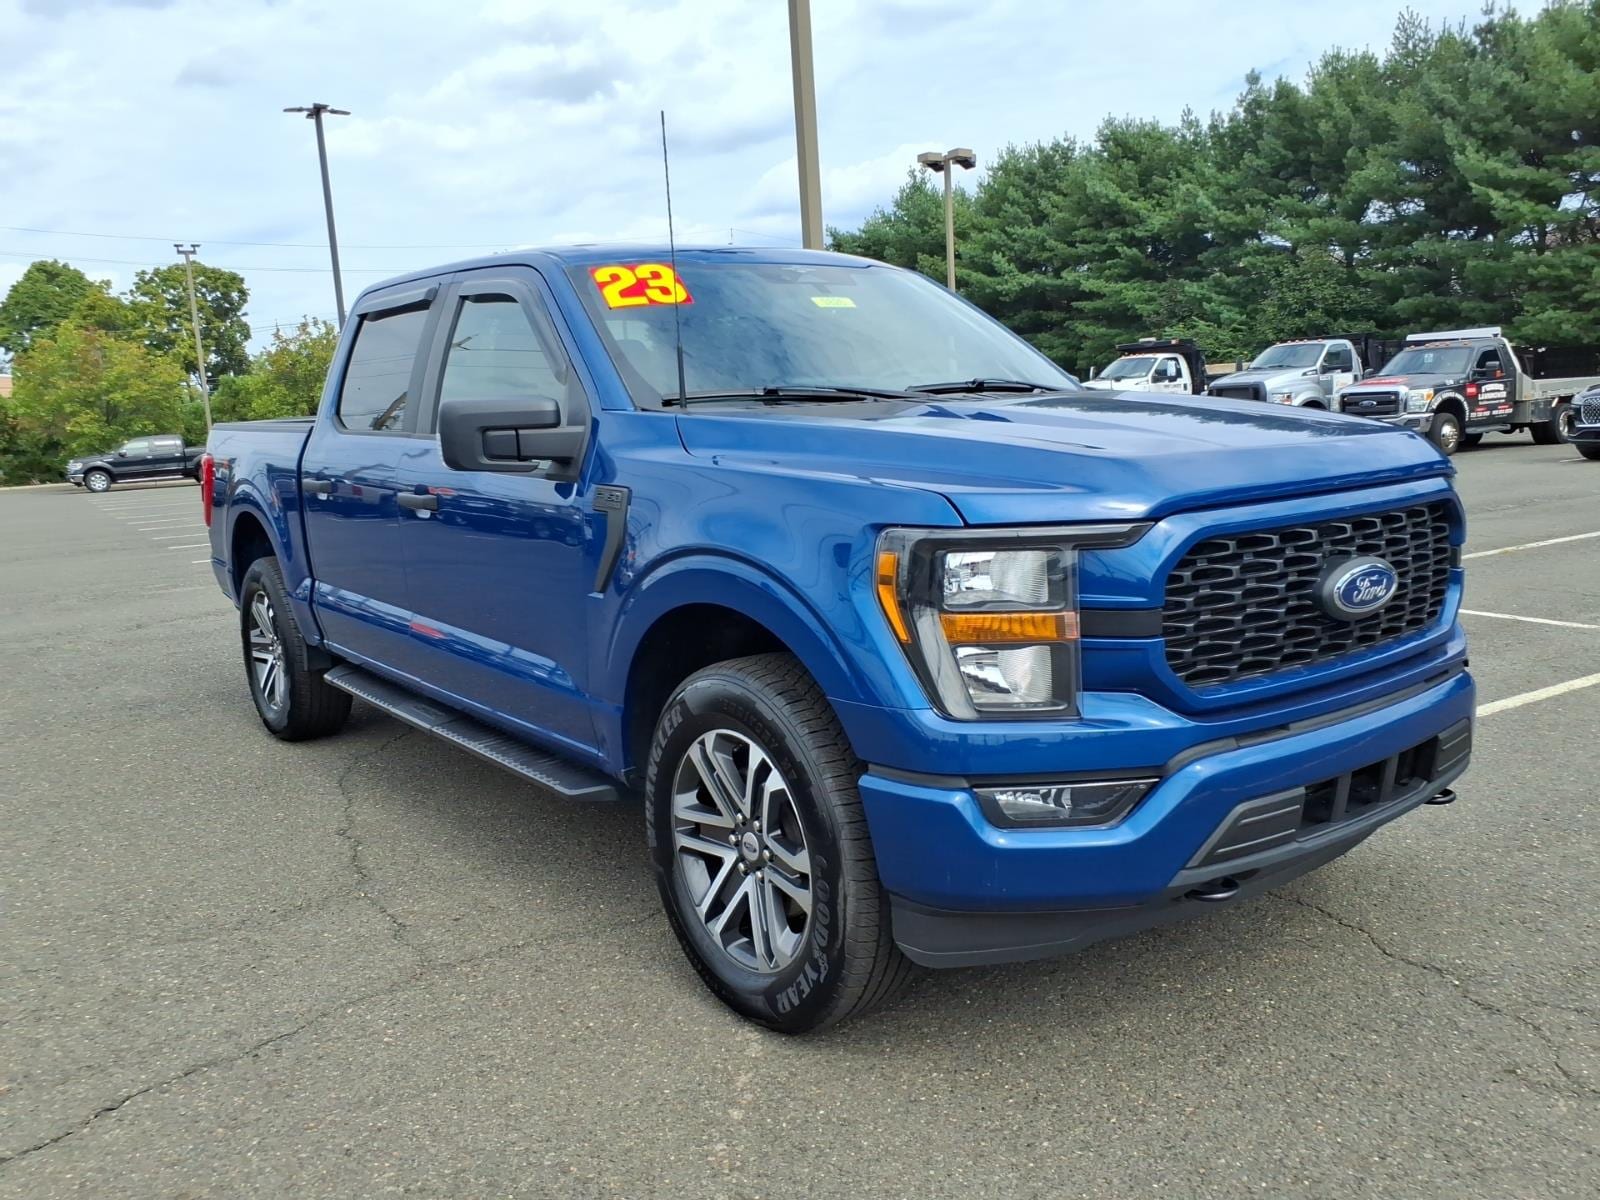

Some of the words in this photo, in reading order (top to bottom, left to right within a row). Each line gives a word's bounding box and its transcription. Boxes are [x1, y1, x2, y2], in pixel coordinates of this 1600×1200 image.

[594, 263, 687, 307] 23
[1353, 574, 1387, 603] Ford
[645, 705, 684, 847] WRANGLER
